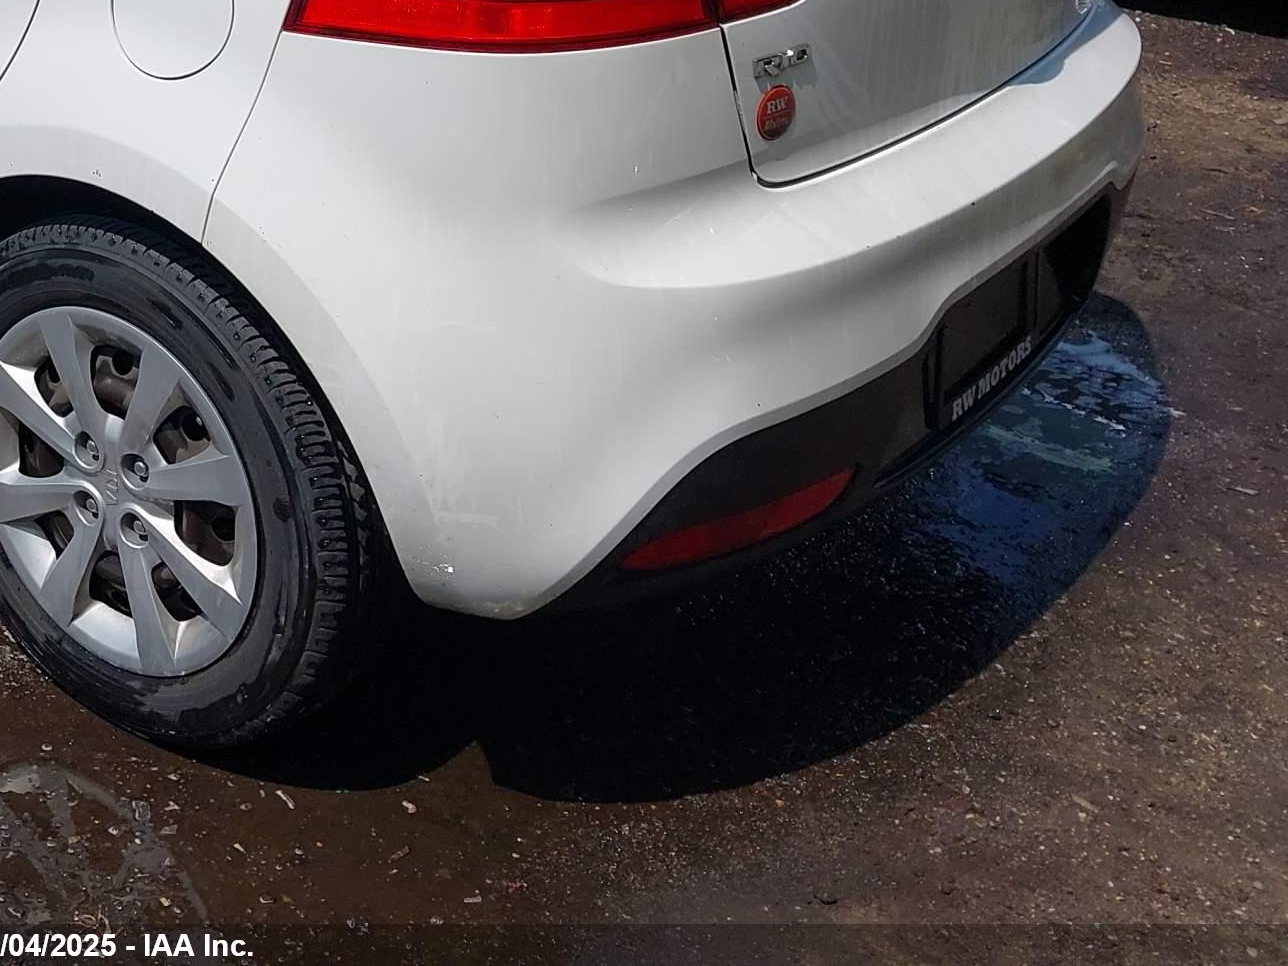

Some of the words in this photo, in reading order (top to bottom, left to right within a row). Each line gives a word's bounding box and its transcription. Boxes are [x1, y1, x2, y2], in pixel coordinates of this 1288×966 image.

[766, 97, 788, 115] RW
[952, 384, 977, 421] RW
[978, 336, 1031, 399] MOTORS
